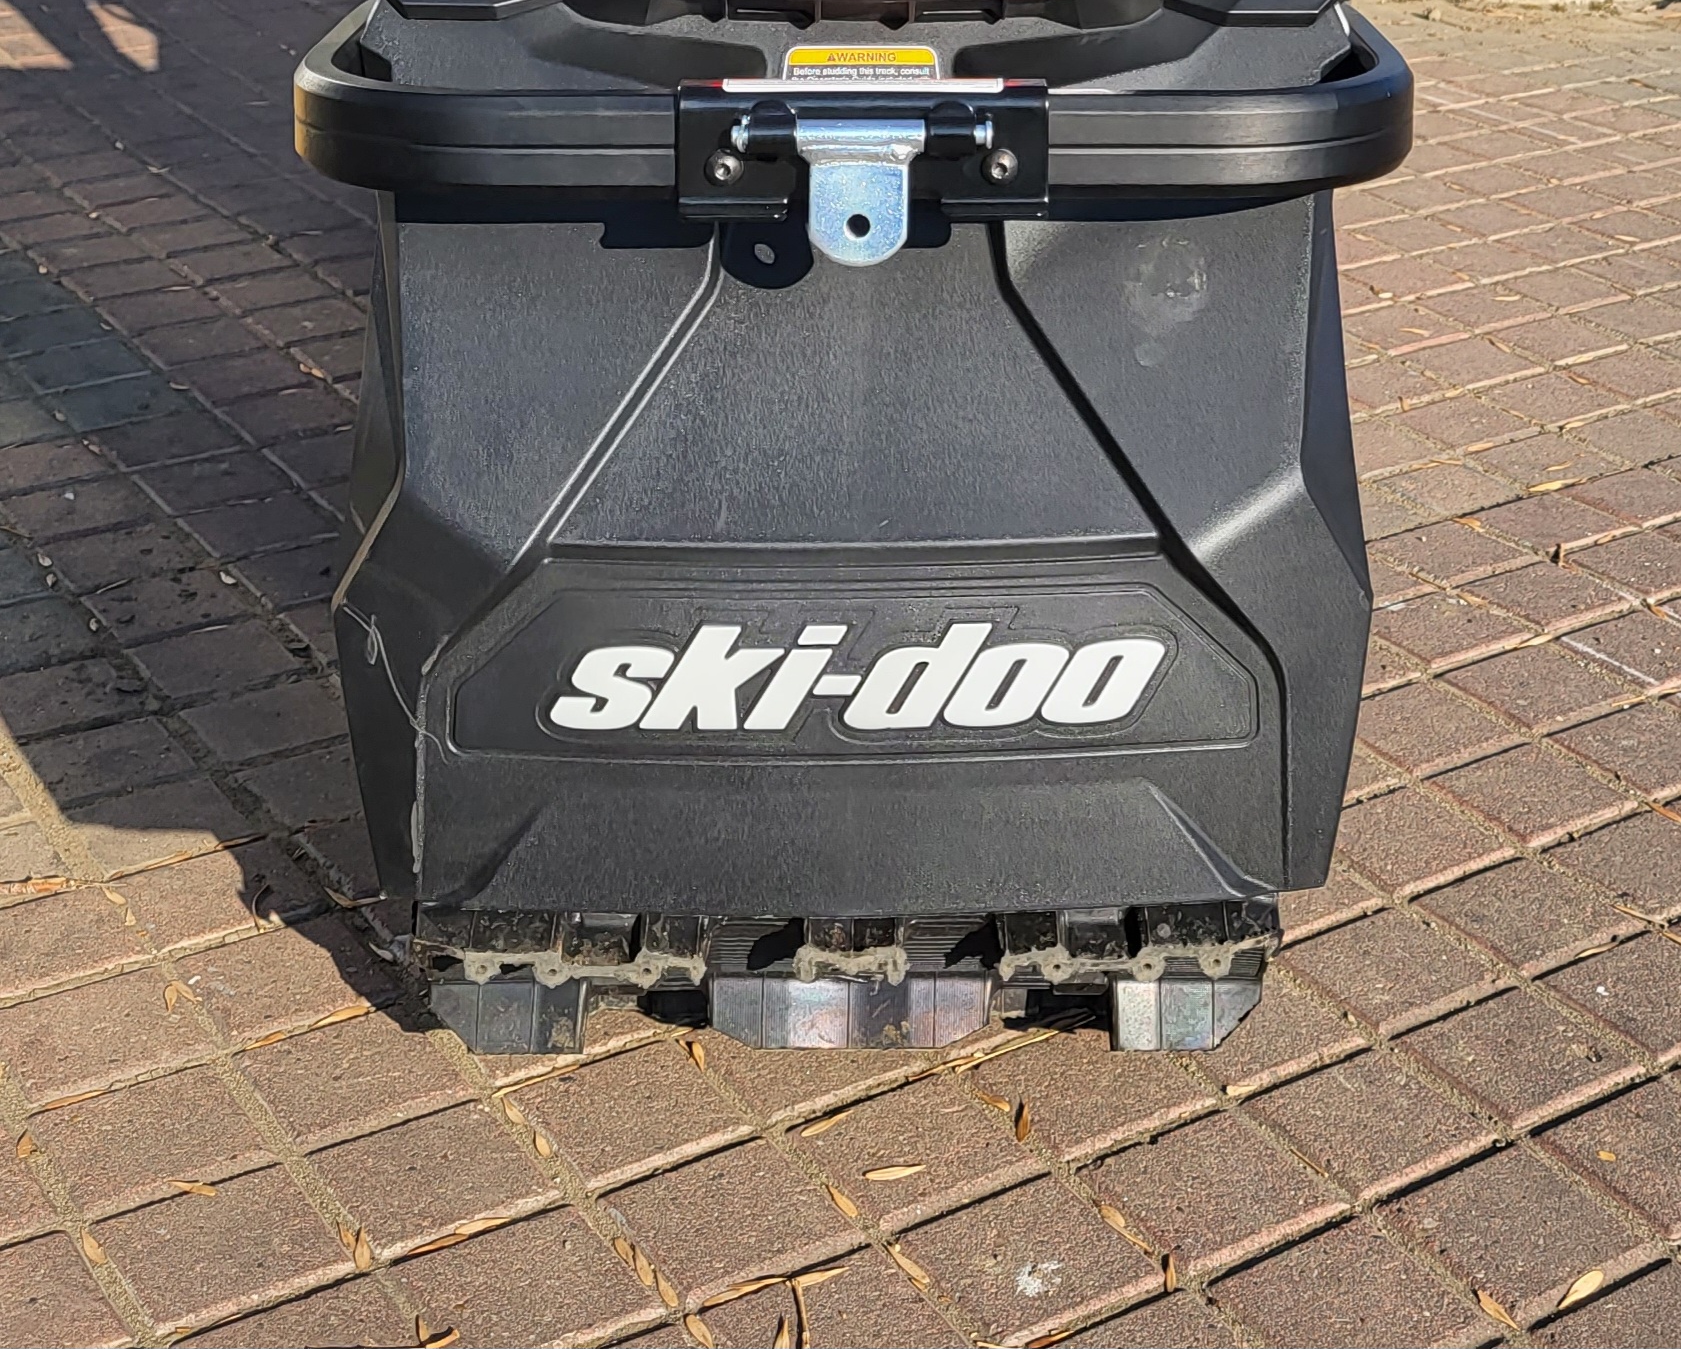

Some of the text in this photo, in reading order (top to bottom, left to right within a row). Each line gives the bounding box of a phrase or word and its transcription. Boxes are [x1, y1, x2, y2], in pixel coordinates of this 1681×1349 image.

[837, 52, 896, 62] WARNING
[793, 67, 821, 76] Before
[859, 67, 874, 76] this
[900, 67, 930, 76] consult
[550, 623, 1166, 730] ski-doo
